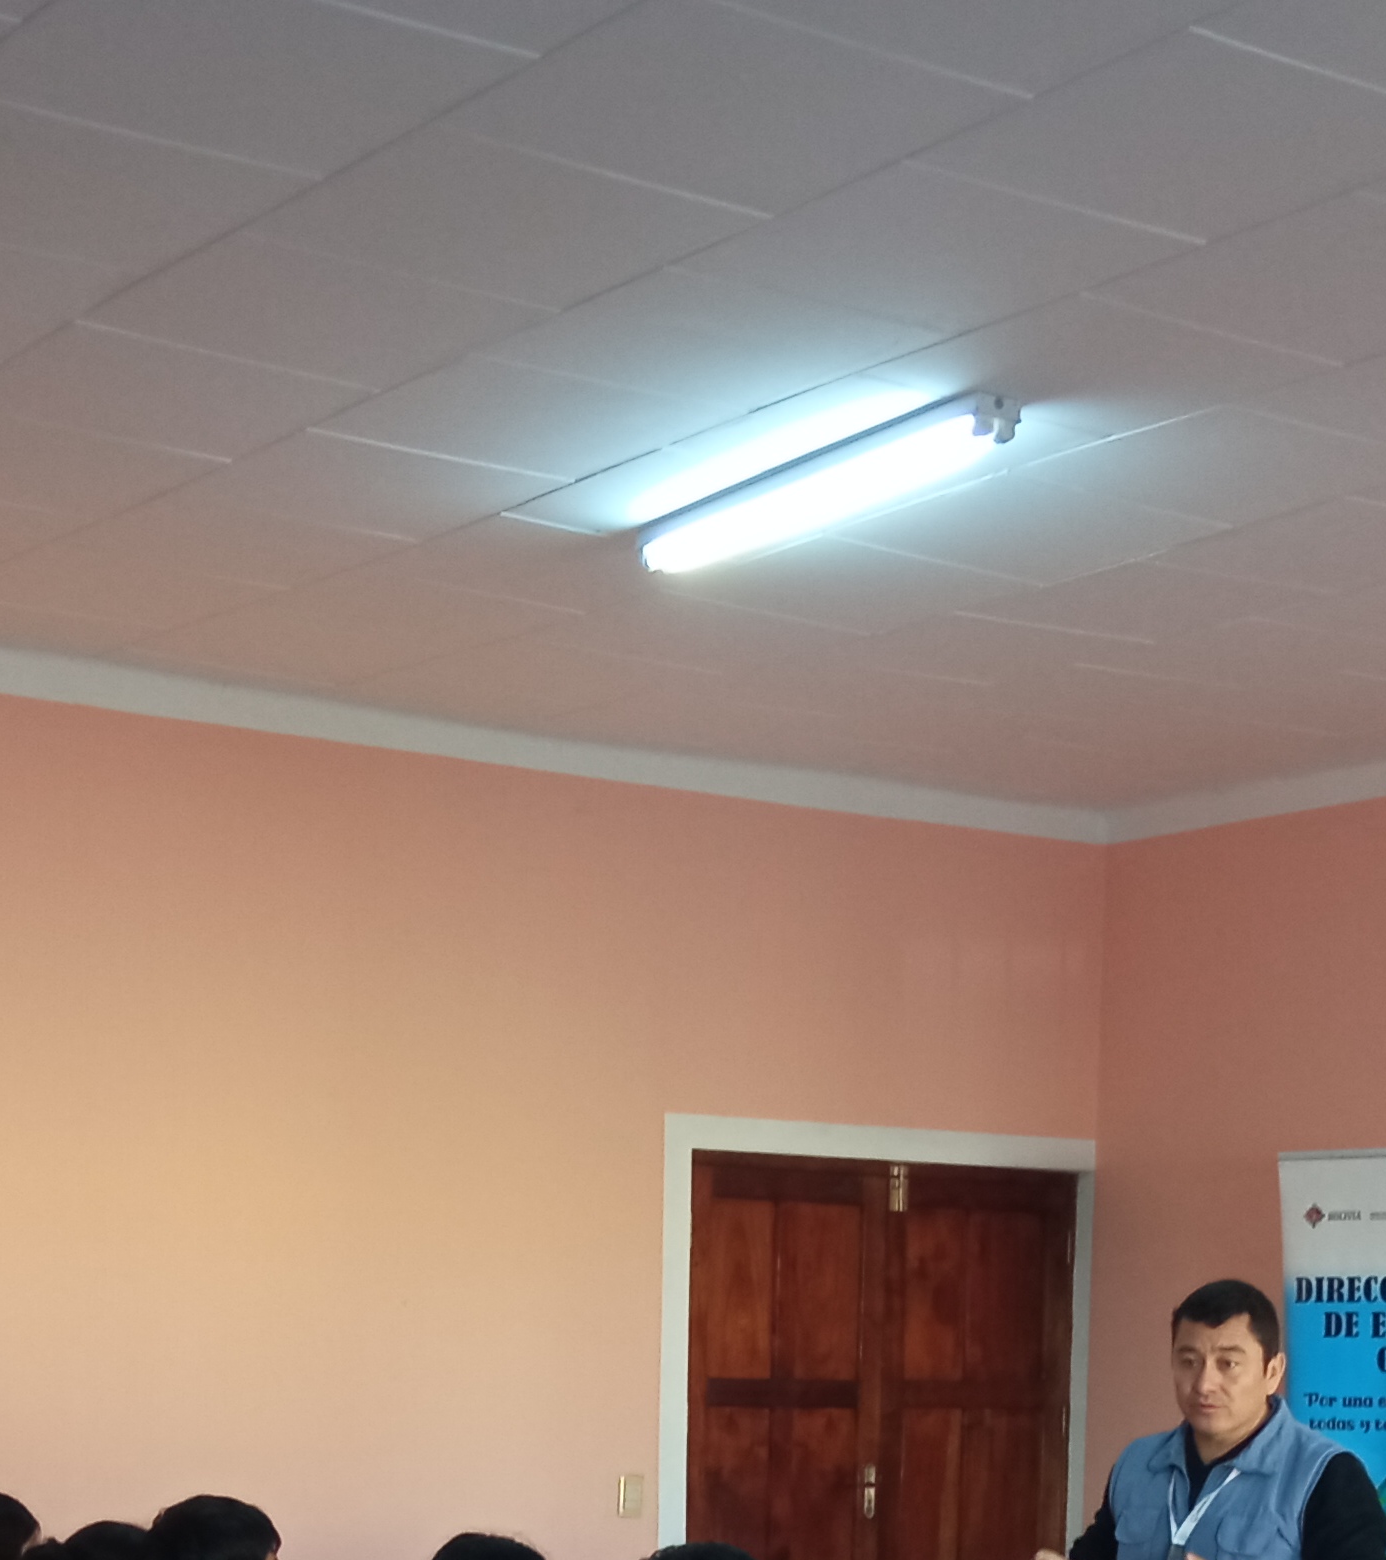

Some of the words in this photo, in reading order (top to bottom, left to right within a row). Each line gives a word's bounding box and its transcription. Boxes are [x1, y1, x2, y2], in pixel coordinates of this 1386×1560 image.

[1323, 1311, 1359, 1338] DE
[1343, 1396, 1373, 1408] una
[1309, 1417, 1355, 1431] todas
[1360, 1420, 1371, 1434] y
